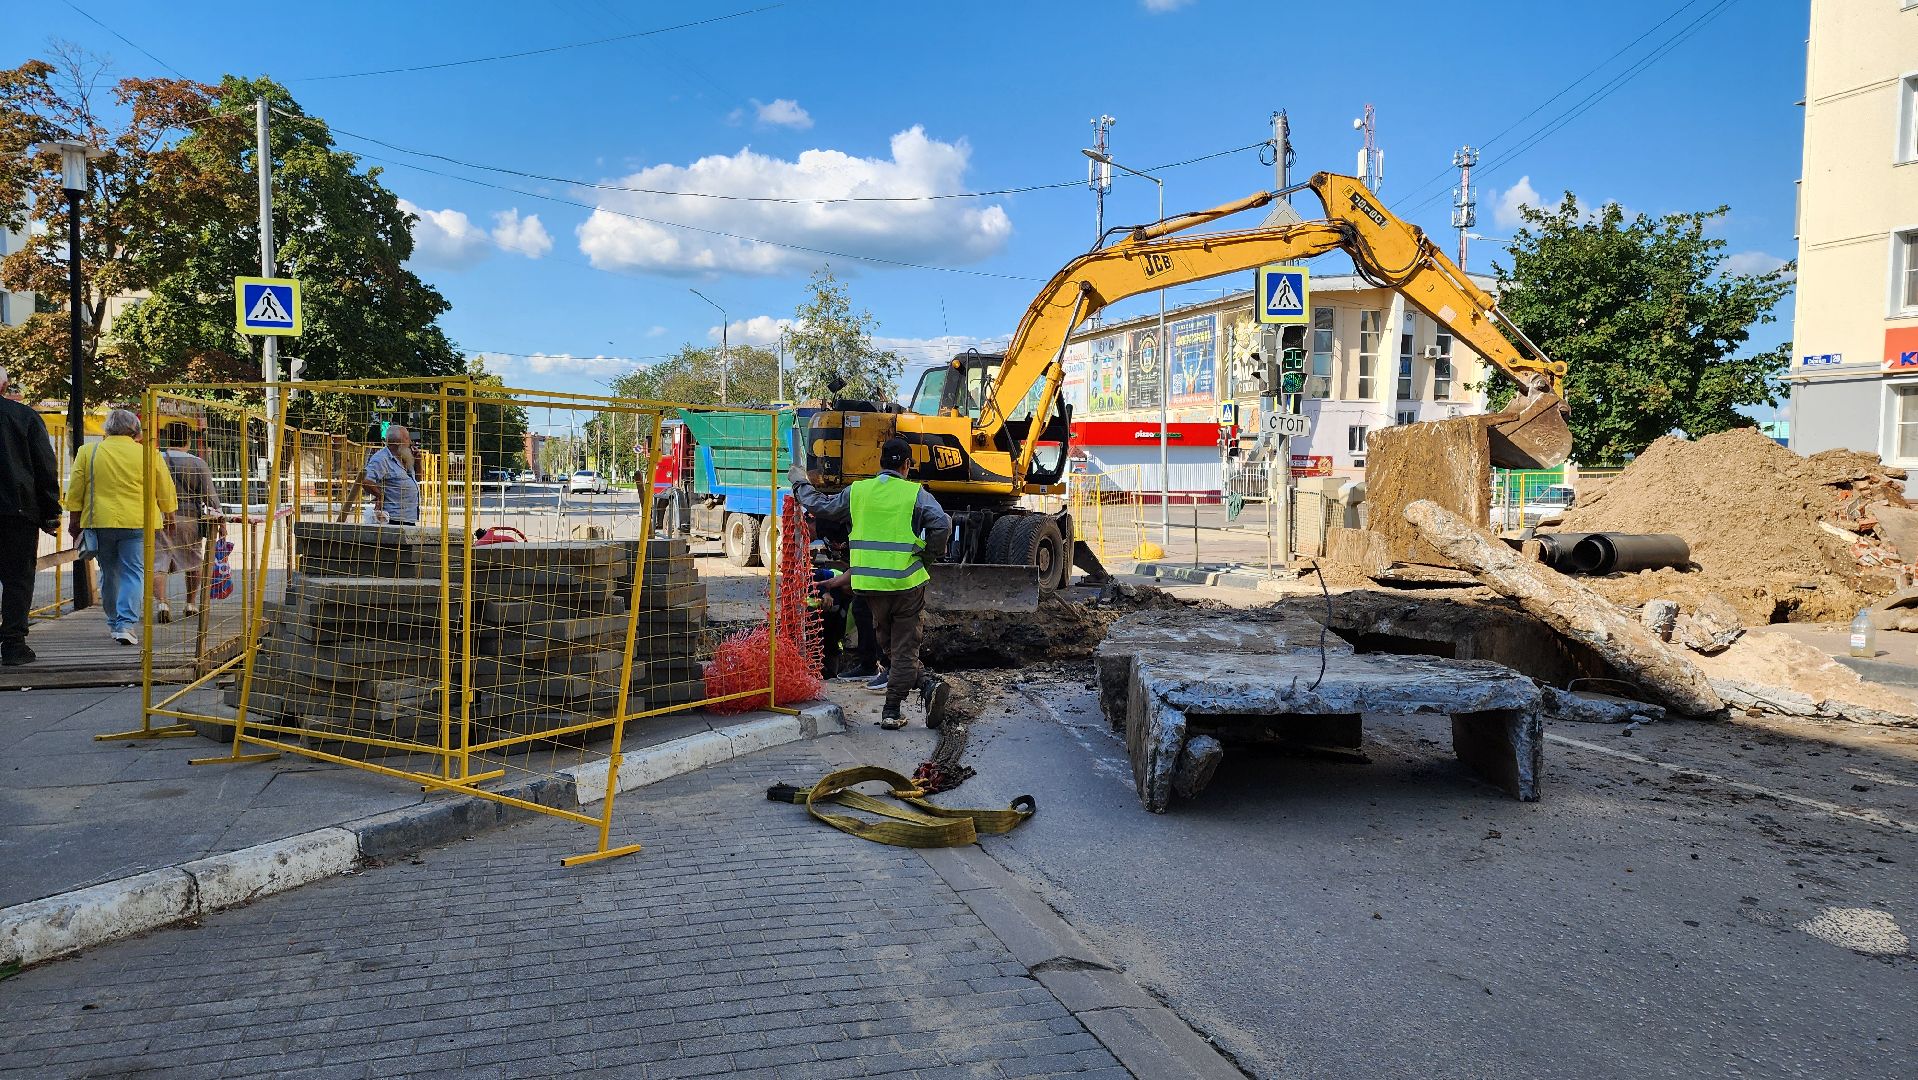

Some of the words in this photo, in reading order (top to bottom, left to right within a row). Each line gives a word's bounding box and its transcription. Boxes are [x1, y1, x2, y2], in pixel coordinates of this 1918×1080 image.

[1145, 254, 1172, 276] JCB
[1285, 350, 1302, 368] 26
[1901, 351, 1918, 367] К
[1269, 415, 1304, 433] СТОП
[936, 447, 961, 469] JCB
